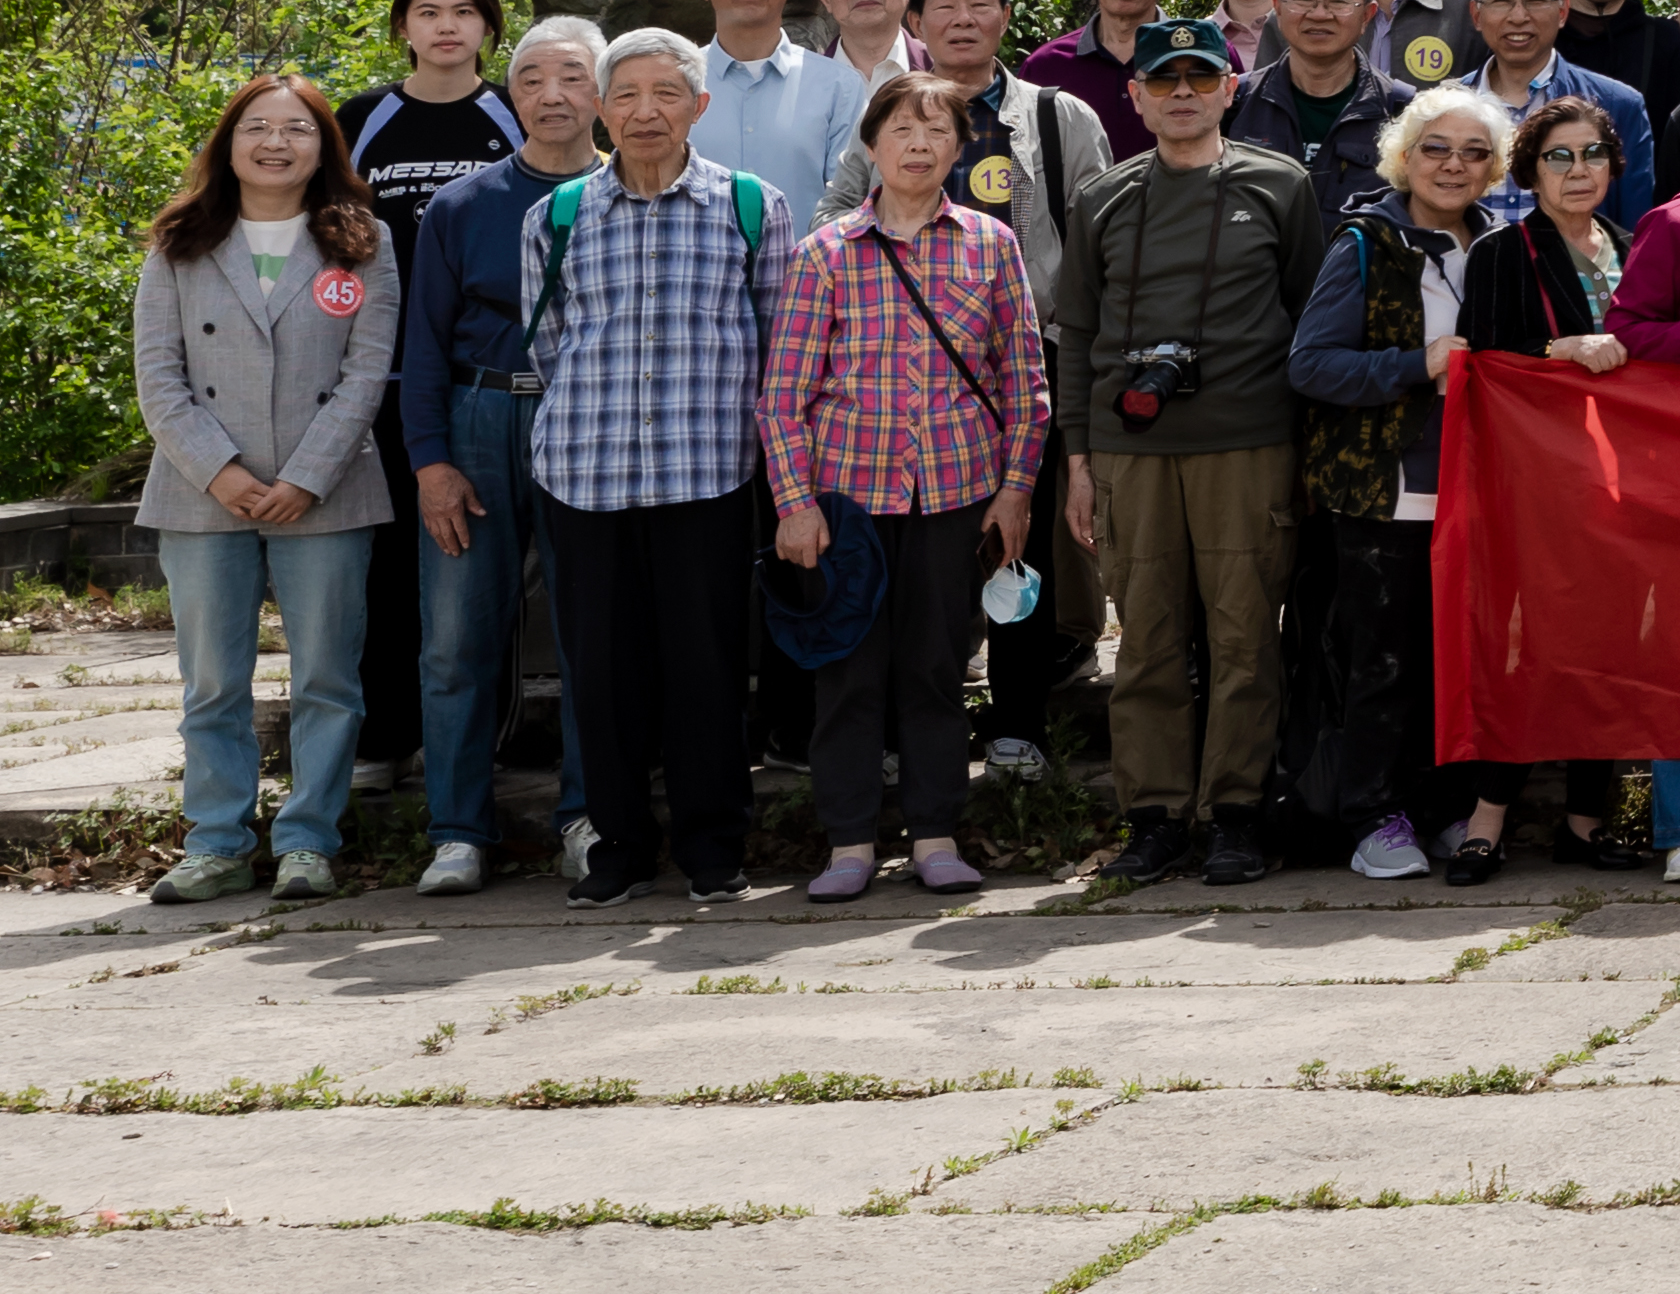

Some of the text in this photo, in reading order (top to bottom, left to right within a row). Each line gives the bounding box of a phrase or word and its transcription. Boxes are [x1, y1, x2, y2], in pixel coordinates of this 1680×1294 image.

[1415, 47, 1443, 69] 19
[981, 168, 1013, 191] 13
[322, 280, 355, 305] 45
